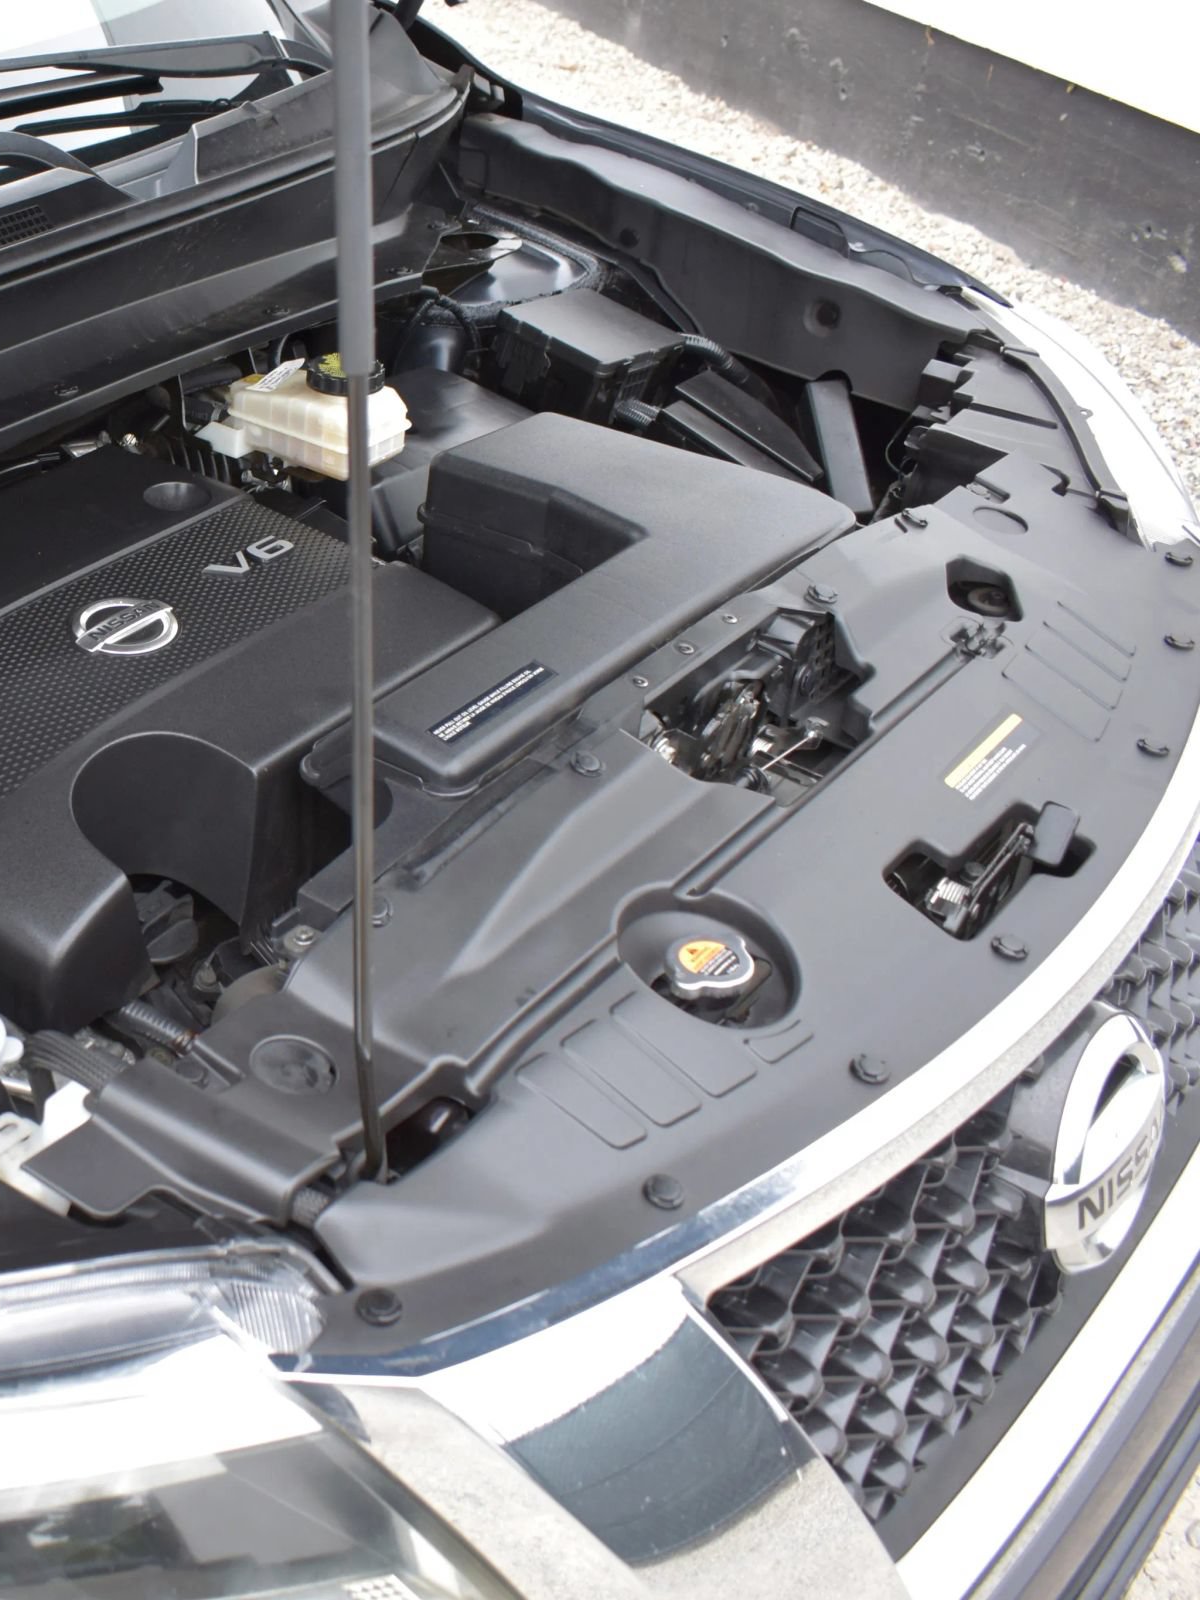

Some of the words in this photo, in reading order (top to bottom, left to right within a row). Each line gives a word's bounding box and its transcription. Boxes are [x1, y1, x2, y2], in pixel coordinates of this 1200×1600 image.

[201, 535, 294, 576] V6
[88, 602, 159, 640] NISSAN
[1078, 1104, 1163, 1230] NISSA
